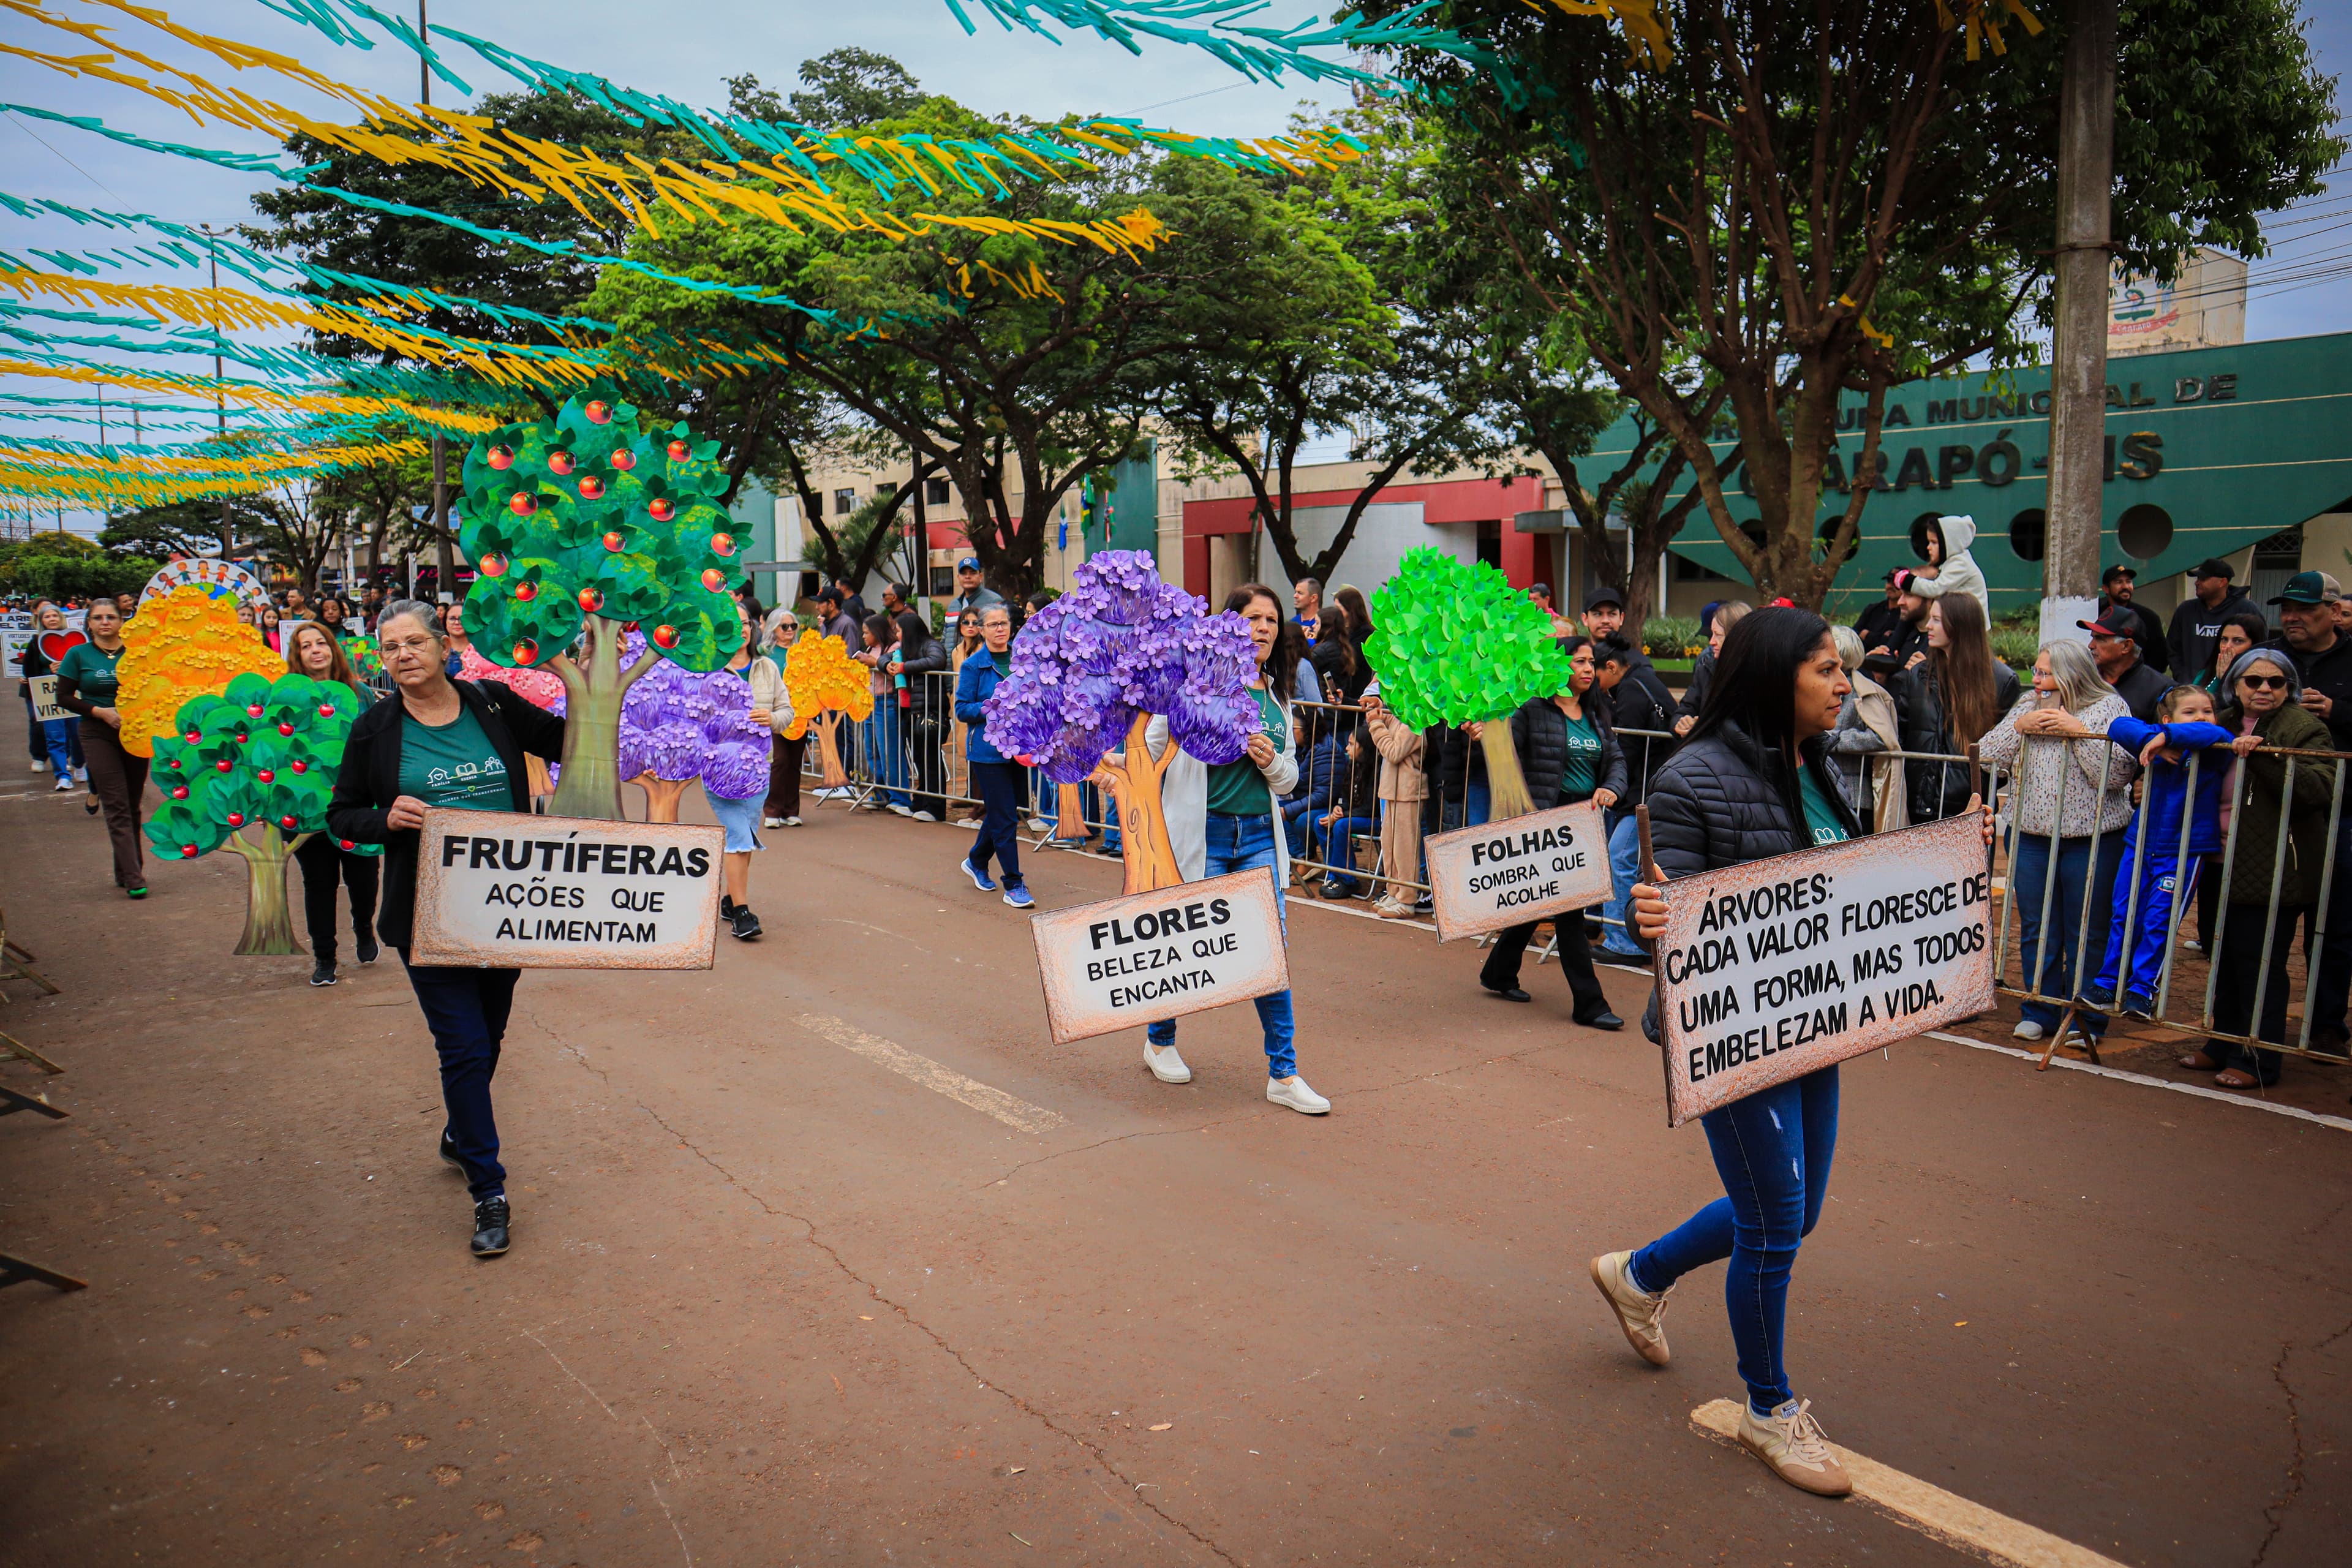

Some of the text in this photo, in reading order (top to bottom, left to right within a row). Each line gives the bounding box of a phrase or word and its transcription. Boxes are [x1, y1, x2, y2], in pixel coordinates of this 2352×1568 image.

[1927, 382, 2156, 424] MUNICAL
[2174, 374, 2238, 403] DE
[1740, 428, 2021, 498] ARAPÓ
[2196, 623, 2222, 636] VANS
[442, 832, 709, 877] FRUTÍFERAS
[1472, 826, 1574, 866] FOLHAS
[485, 877, 665, 912] AÇÕES QUE
[1469, 852, 1586, 893] SOMBRA QUE
[1496, 881, 1560, 909] ACOLHE
[1090, 899, 1231, 950] FLORES
[1698, 873, 1834, 935] ÁRVORES:
[496, 918, 656, 943] ALIMENTAM
[1666, 872, 1988, 985] CADA VALOR FLORESCE DE
[1087, 933, 1238, 981] BELEZA QUE
[1680, 923, 1986, 1033] UMA FORMA, MAS TODOS
[1110, 970, 1215, 1008] ENCANTA
[1689, 979, 1944, 1083] EMBELEZAM A VIDA.
